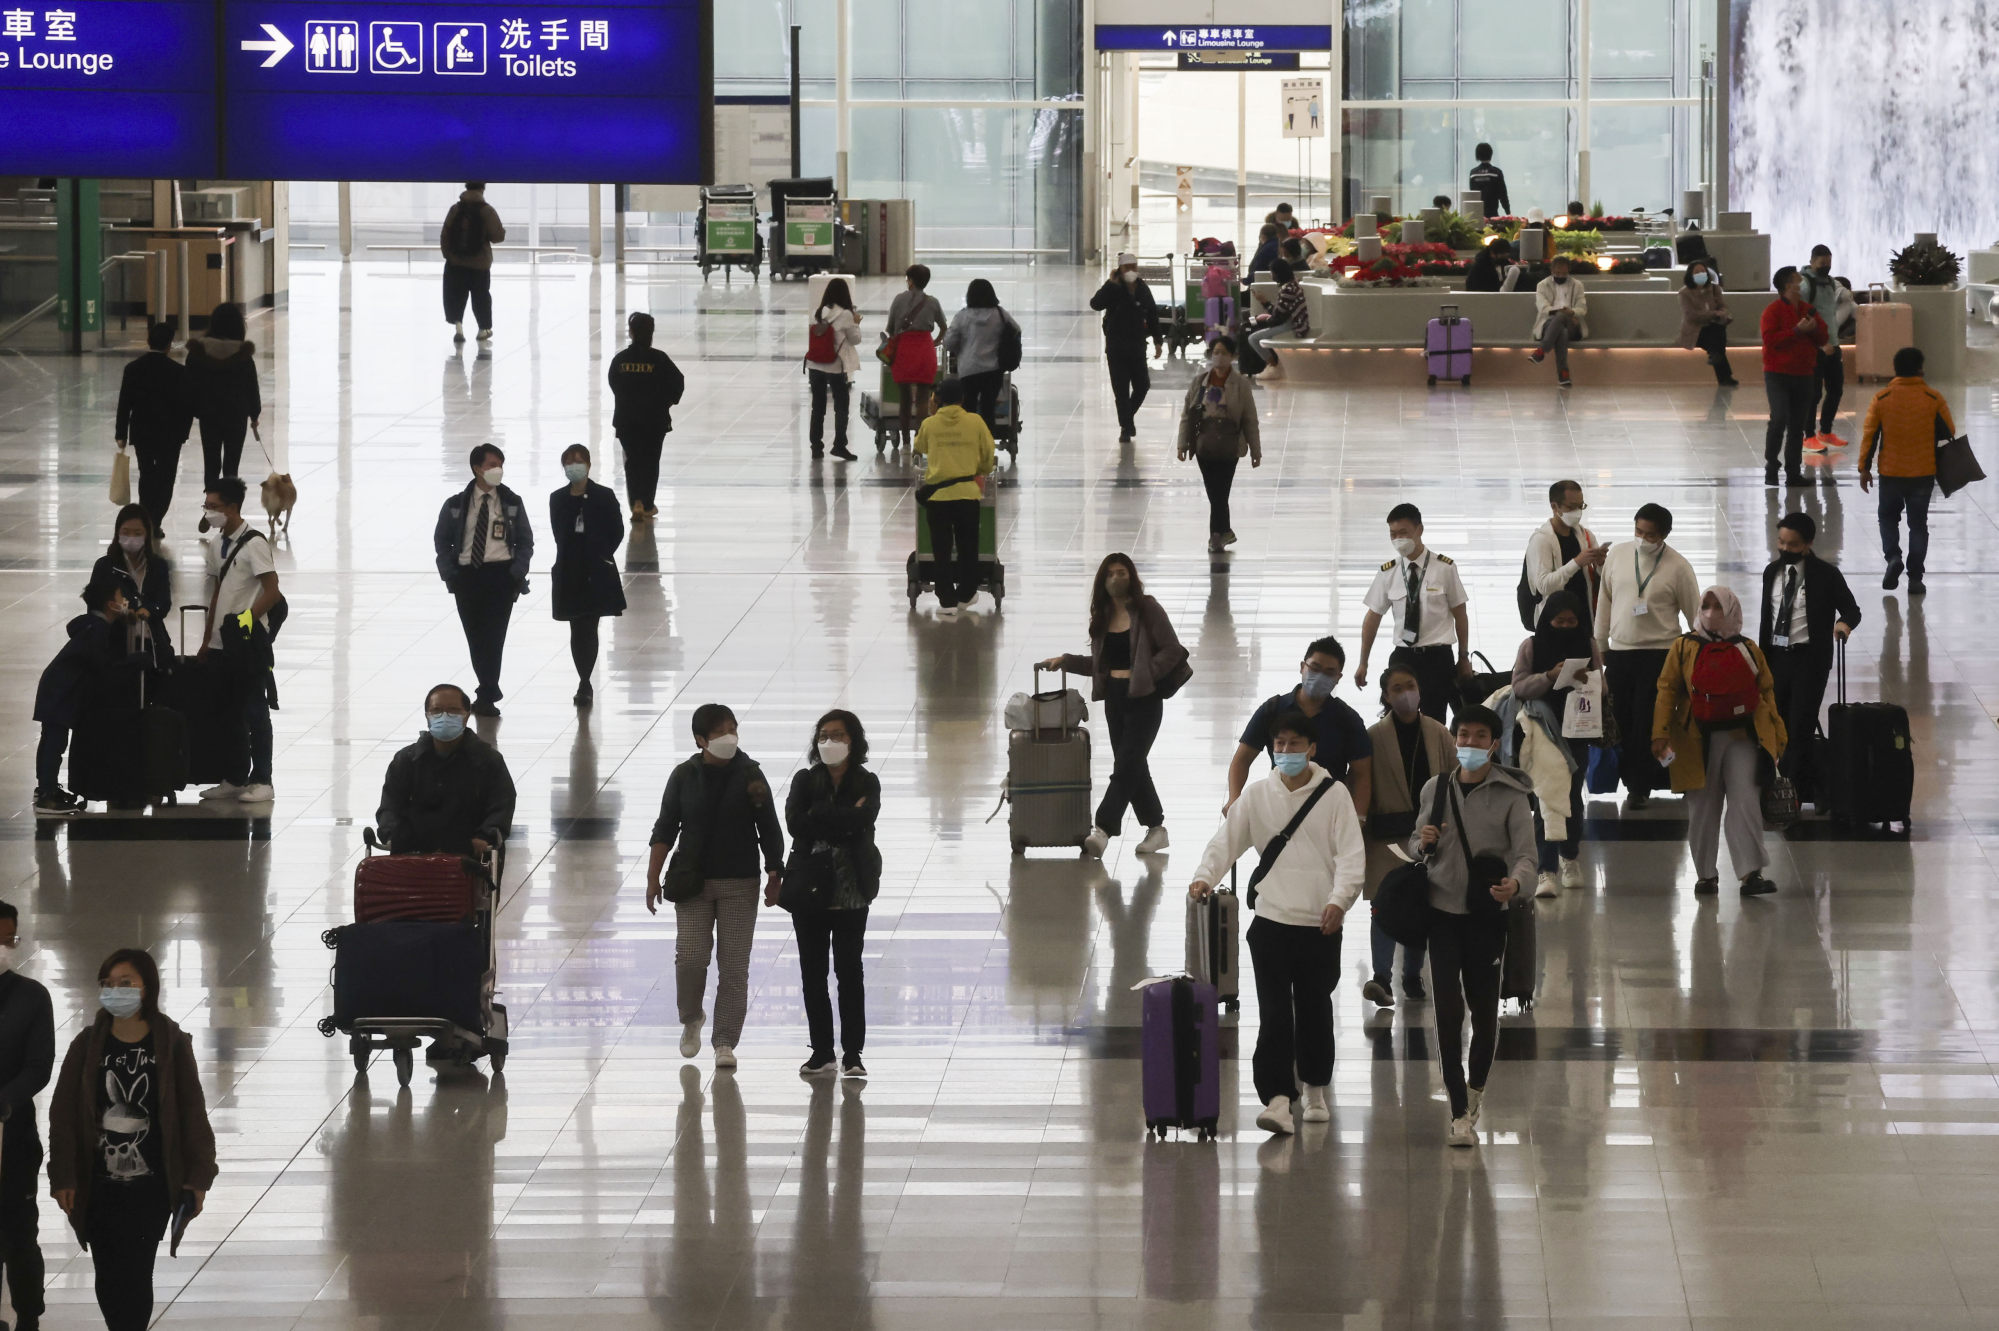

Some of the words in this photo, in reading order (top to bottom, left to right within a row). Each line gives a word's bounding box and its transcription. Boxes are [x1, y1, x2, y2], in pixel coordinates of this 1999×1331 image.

[2, 8, 77, 41] 車室
[499, 18, 609, 51] 洗手間
[1237, 40, 1265, 49] Lounge
[19, 47, 114, 75] Lounge
[499, 53, 577, 77] Toilets
[1249, 57, 1273, 65] Lounge
